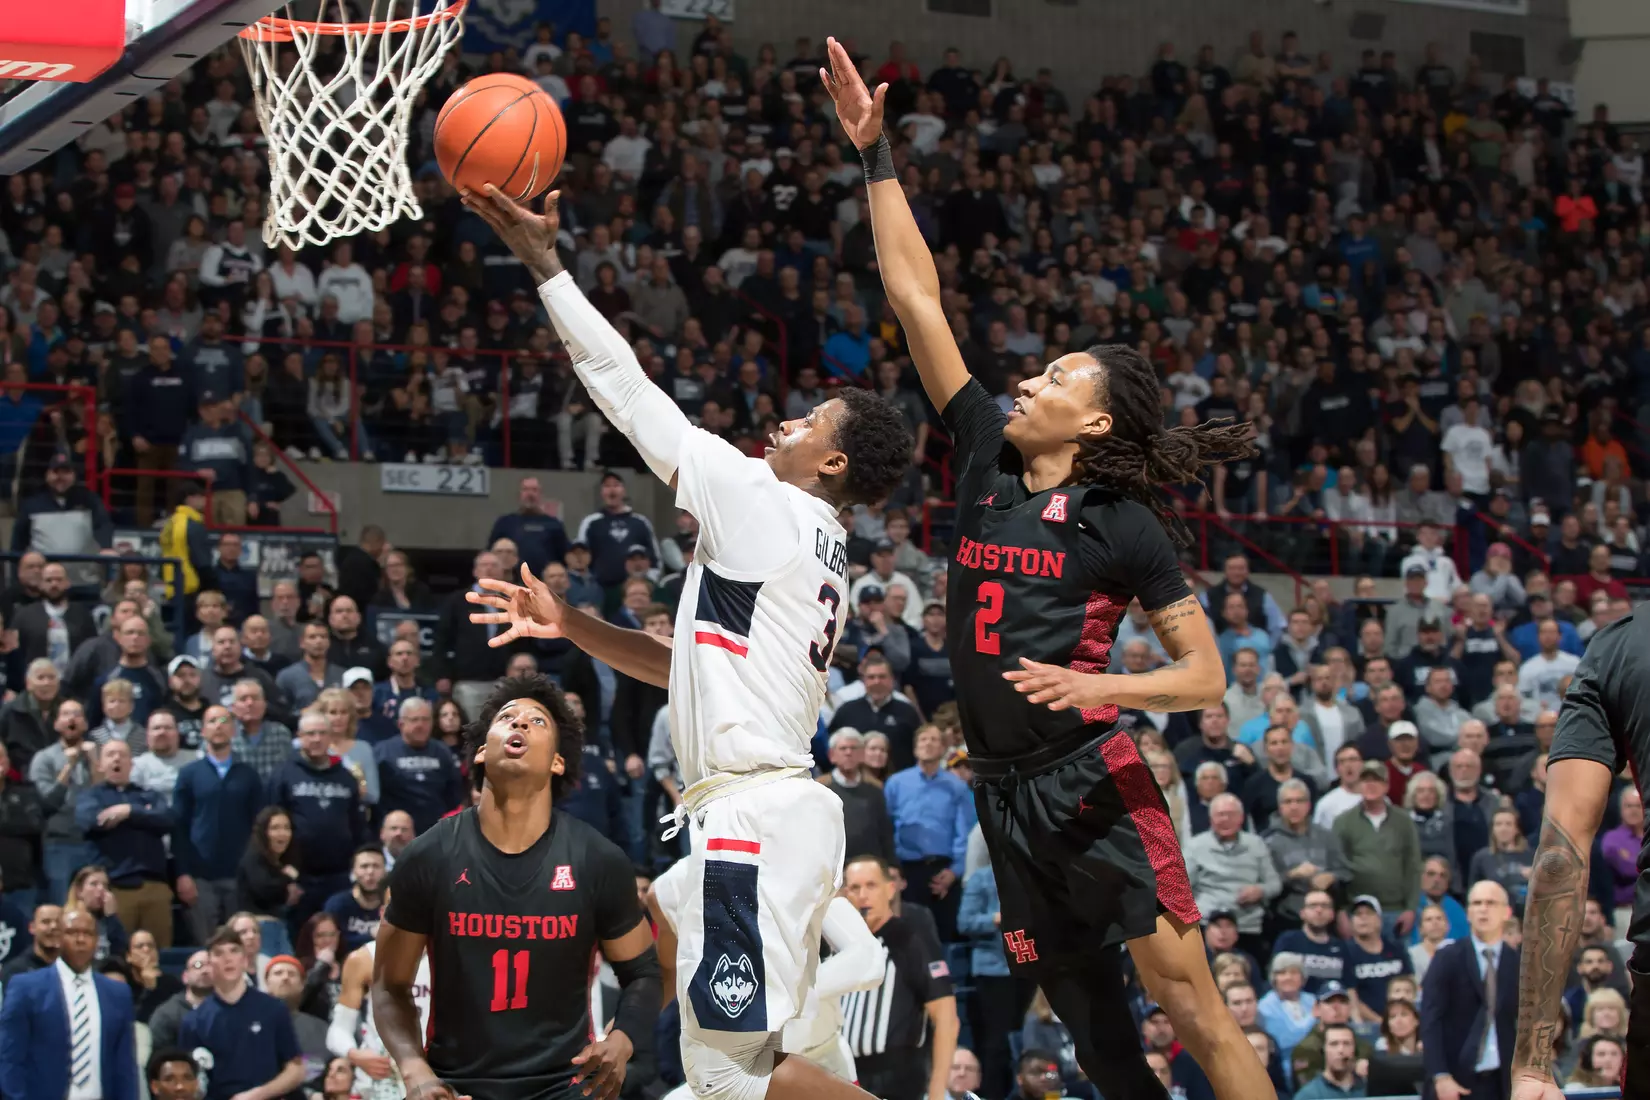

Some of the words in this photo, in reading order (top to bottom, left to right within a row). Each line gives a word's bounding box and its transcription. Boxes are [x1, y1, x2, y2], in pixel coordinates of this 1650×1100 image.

[385, 469, 420, 487] SEC
[437, 467, 486, 493] 221
[809, 582, 840, 672] 3
[975, 581, 1005, 656] 2
[448, 911, 578, 940] HOUSTON
[1004, 929, 1038, 963] UH
[490, 949, 530, 1012] 11
